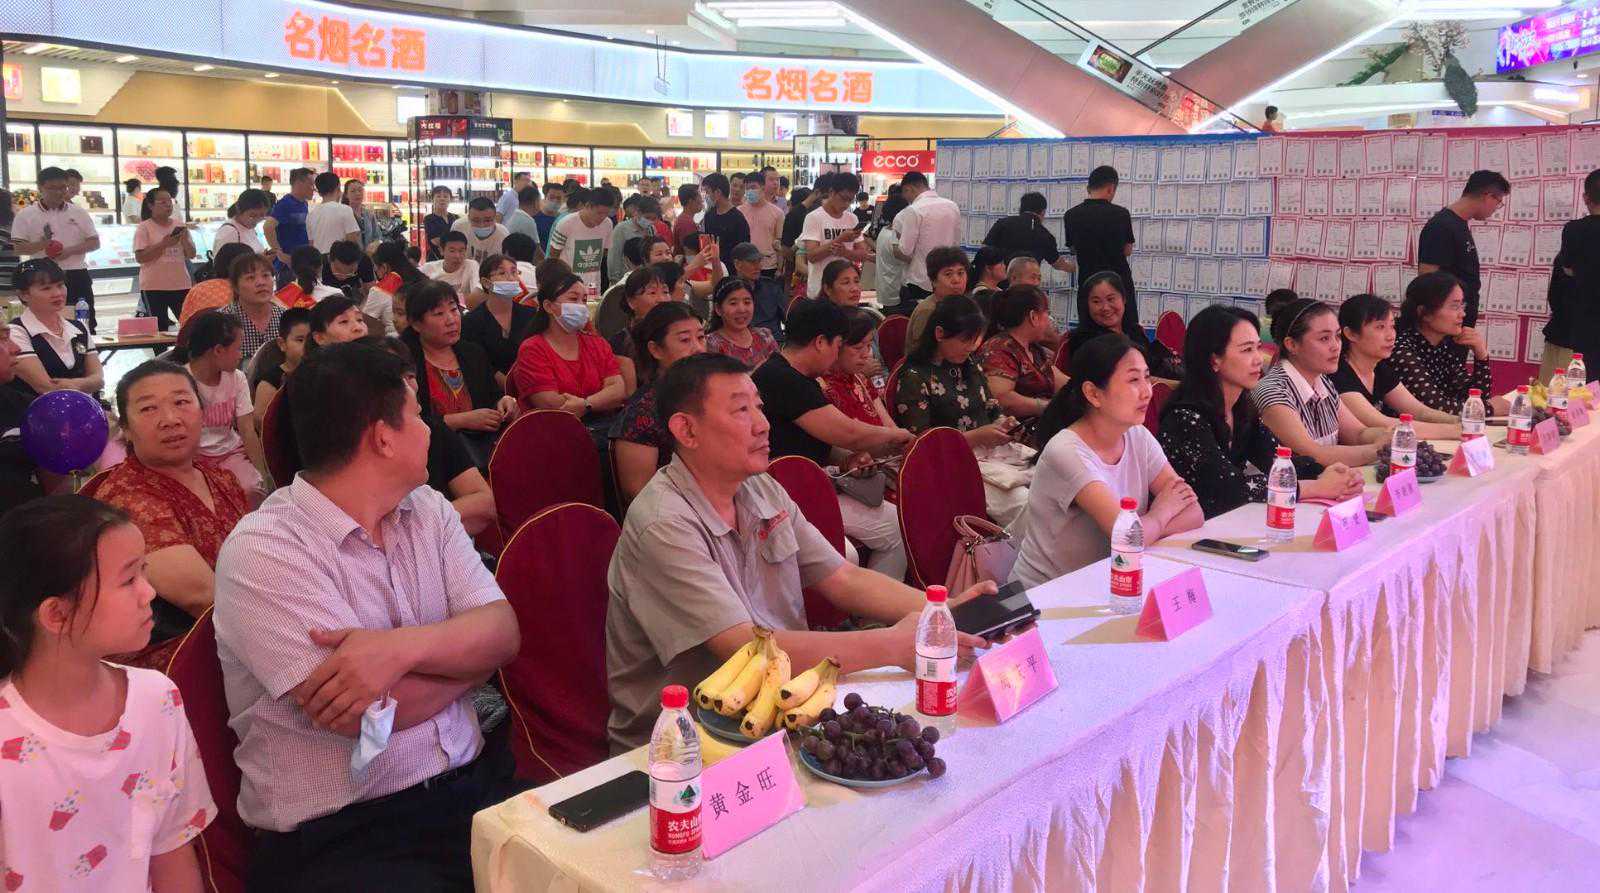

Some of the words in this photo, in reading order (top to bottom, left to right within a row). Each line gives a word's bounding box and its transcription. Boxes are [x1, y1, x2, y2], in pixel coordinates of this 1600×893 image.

[284, 11, 426, 71] 名烟名酒
[742, 66, 874, 104] 名烟名酒
[873, 155, 919, 168] ecco
[709, 767, 777, 820] 黄金旺
